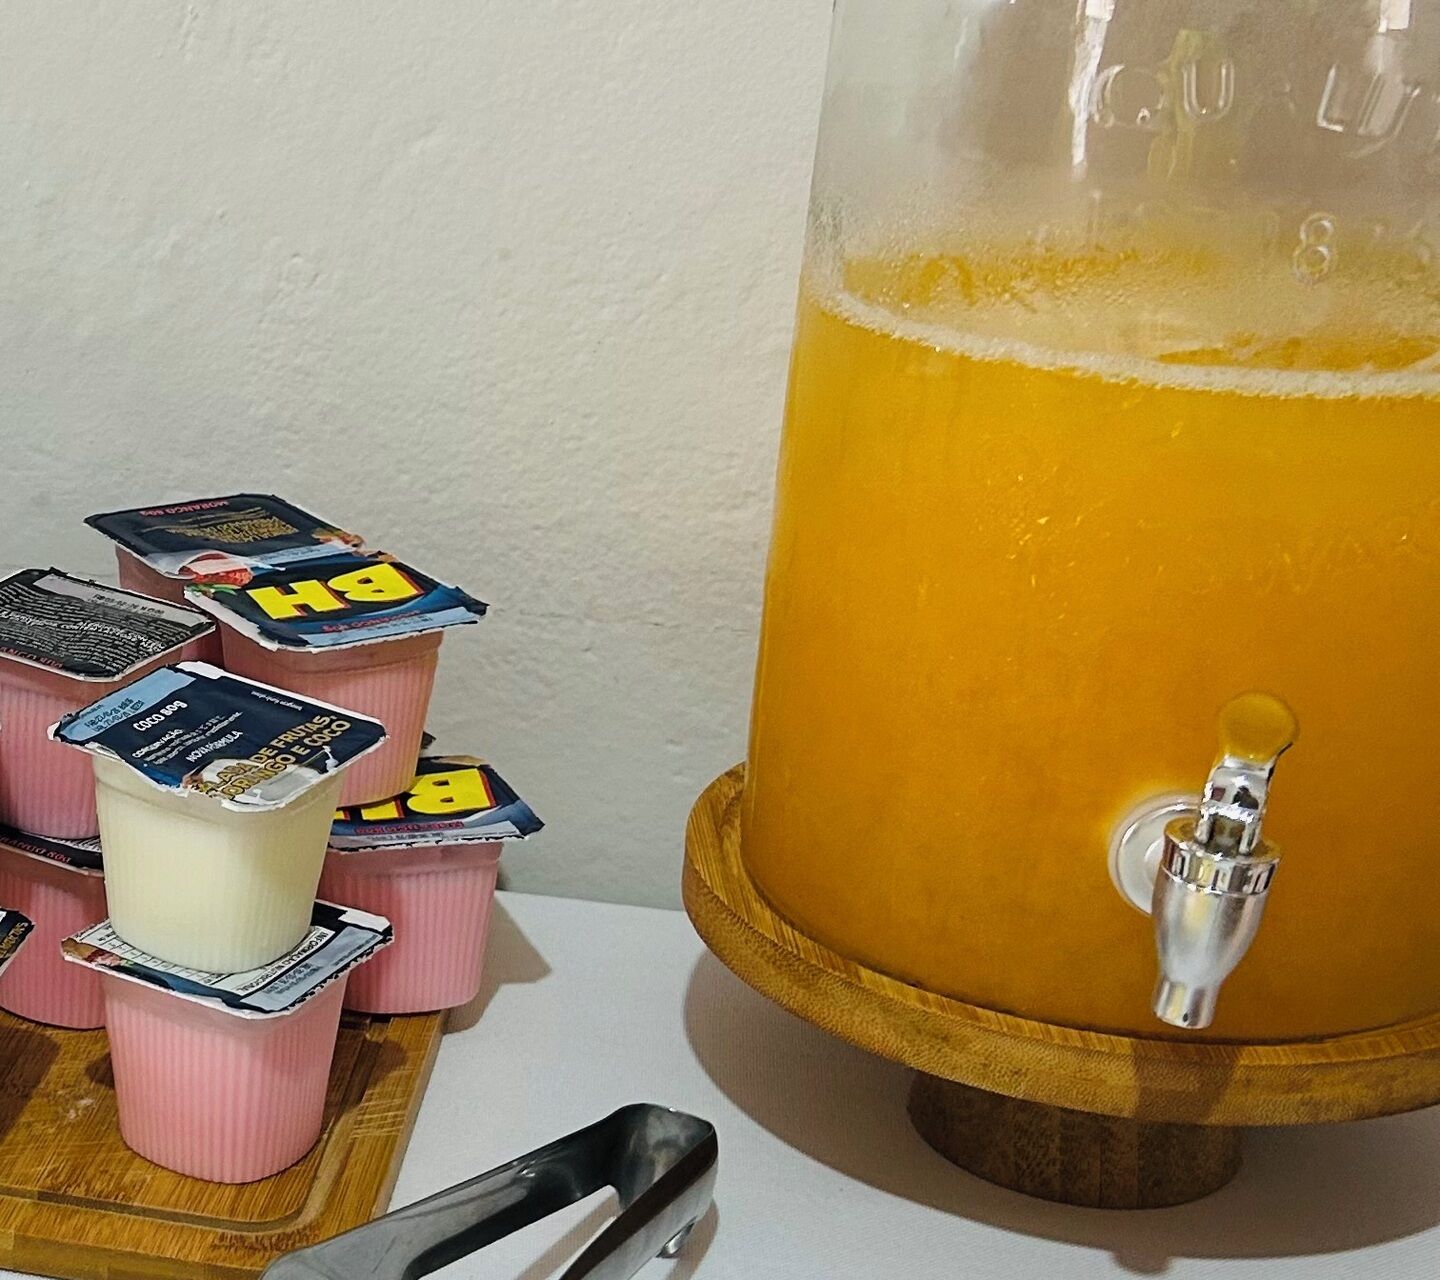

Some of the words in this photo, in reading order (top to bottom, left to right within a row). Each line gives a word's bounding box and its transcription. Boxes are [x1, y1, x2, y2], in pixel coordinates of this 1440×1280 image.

[246, 563, 426, 620] BH
[132, 710, 165, 732] COCO
[160, 698, 188, 717] 80g
[251, 744, 277, 765] DE
[296, 744, 310, 757] E
[303, 718, 352, 747] COCO
